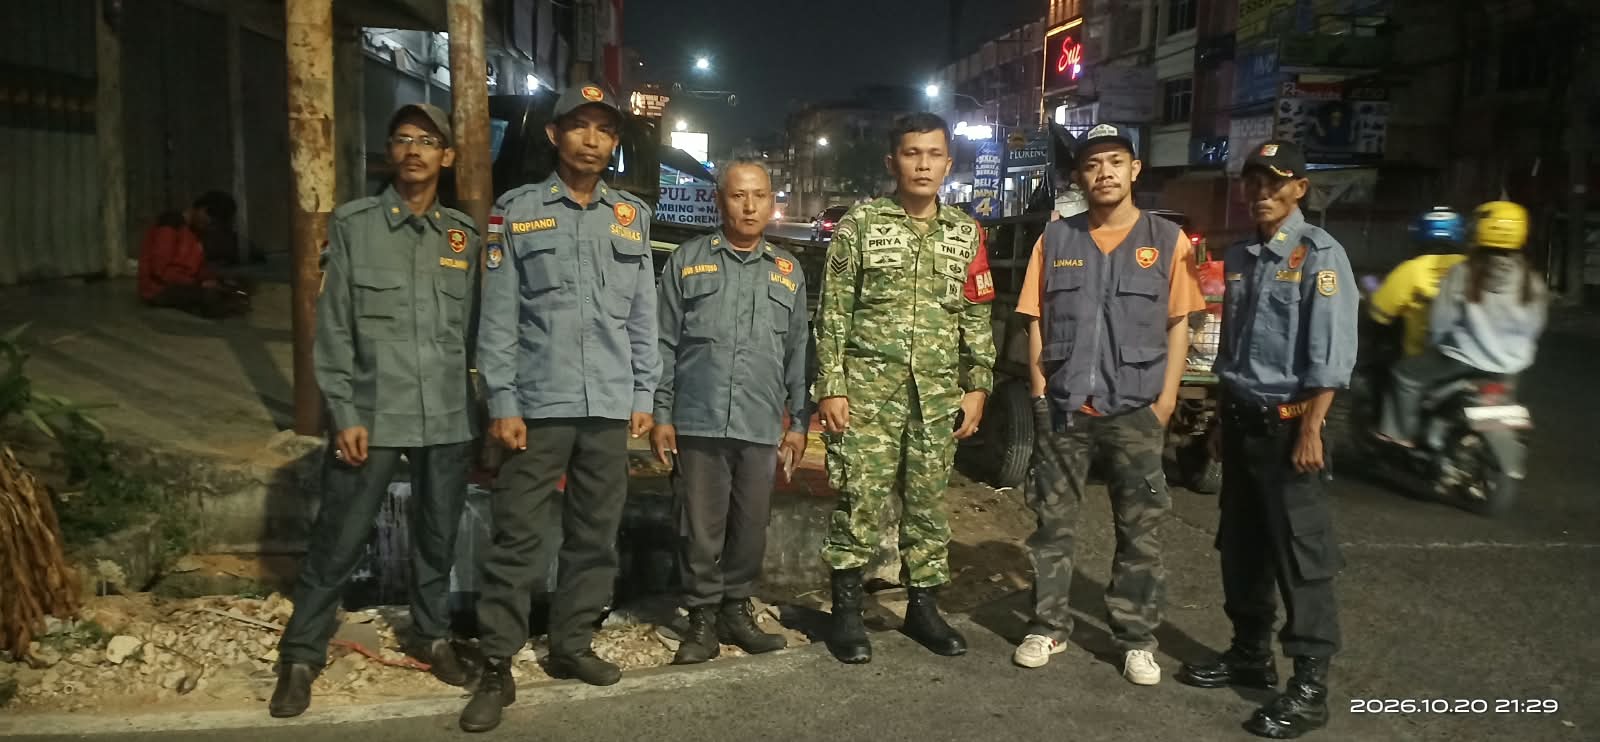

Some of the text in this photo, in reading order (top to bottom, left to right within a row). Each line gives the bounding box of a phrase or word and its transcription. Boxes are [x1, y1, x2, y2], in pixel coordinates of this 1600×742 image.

[976, 197, 992, 216] 4
[512, 219, 555, 232] ROPIANDI
[868, 238, 901, 247] PRIYA
[940, 244, 970, 259] TNI AD
[1053, 259, 1084, 267] LINMAS
